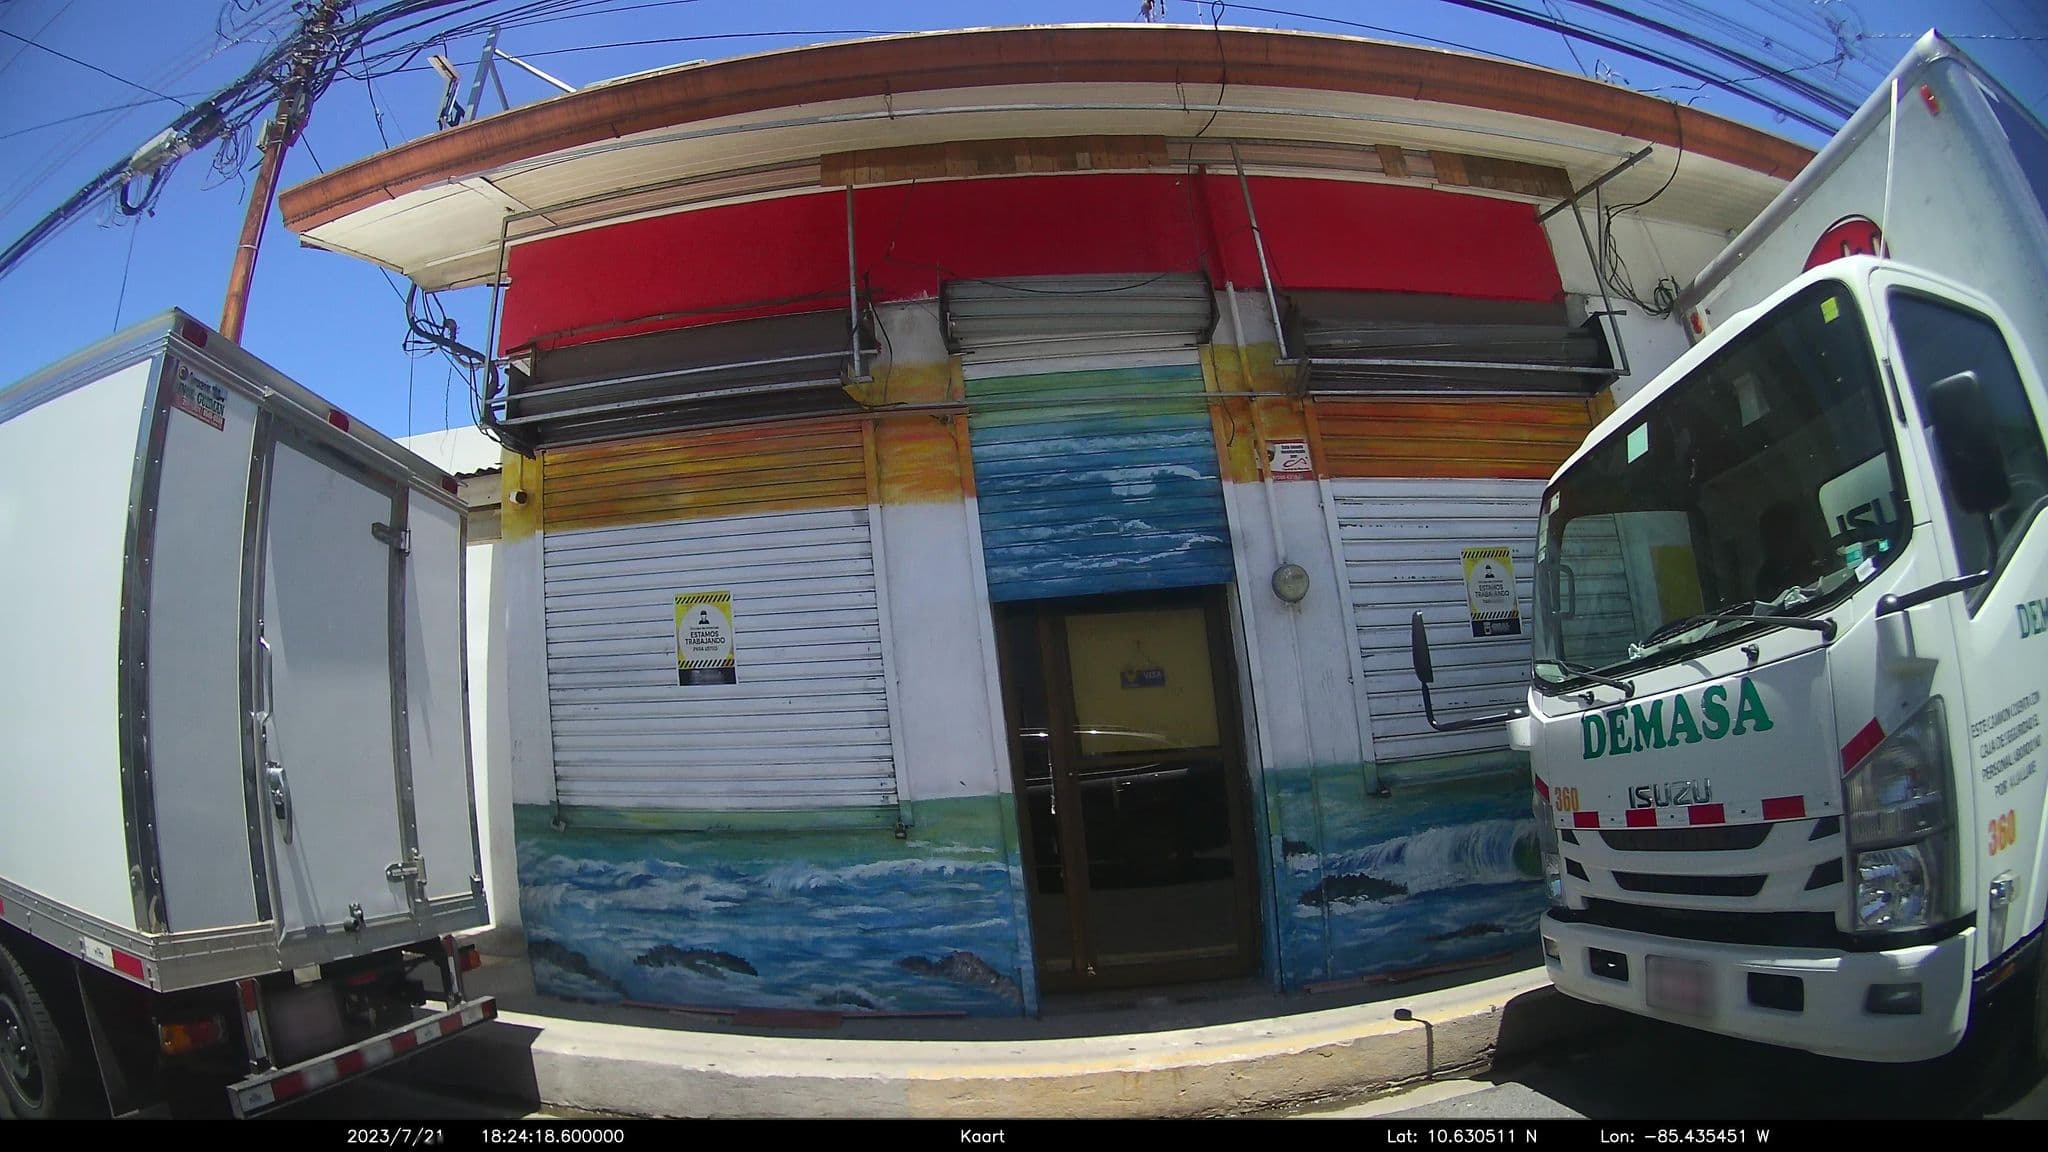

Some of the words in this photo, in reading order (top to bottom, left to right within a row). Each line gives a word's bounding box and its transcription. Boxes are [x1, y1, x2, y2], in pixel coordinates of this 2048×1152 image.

[1478, 584, 1504, 592] ESTAMOS
[685, 637, 726, 646] TRABAJANDO
[690, 630, 719, 639] ESTAMOS
[1582, 676, 1775, 760] DEMASA
[1554, 786, 1580, 812] 360
[1628, 777, 1713, 809] ISUZU
[1988, 809, 2017, 857] 360
